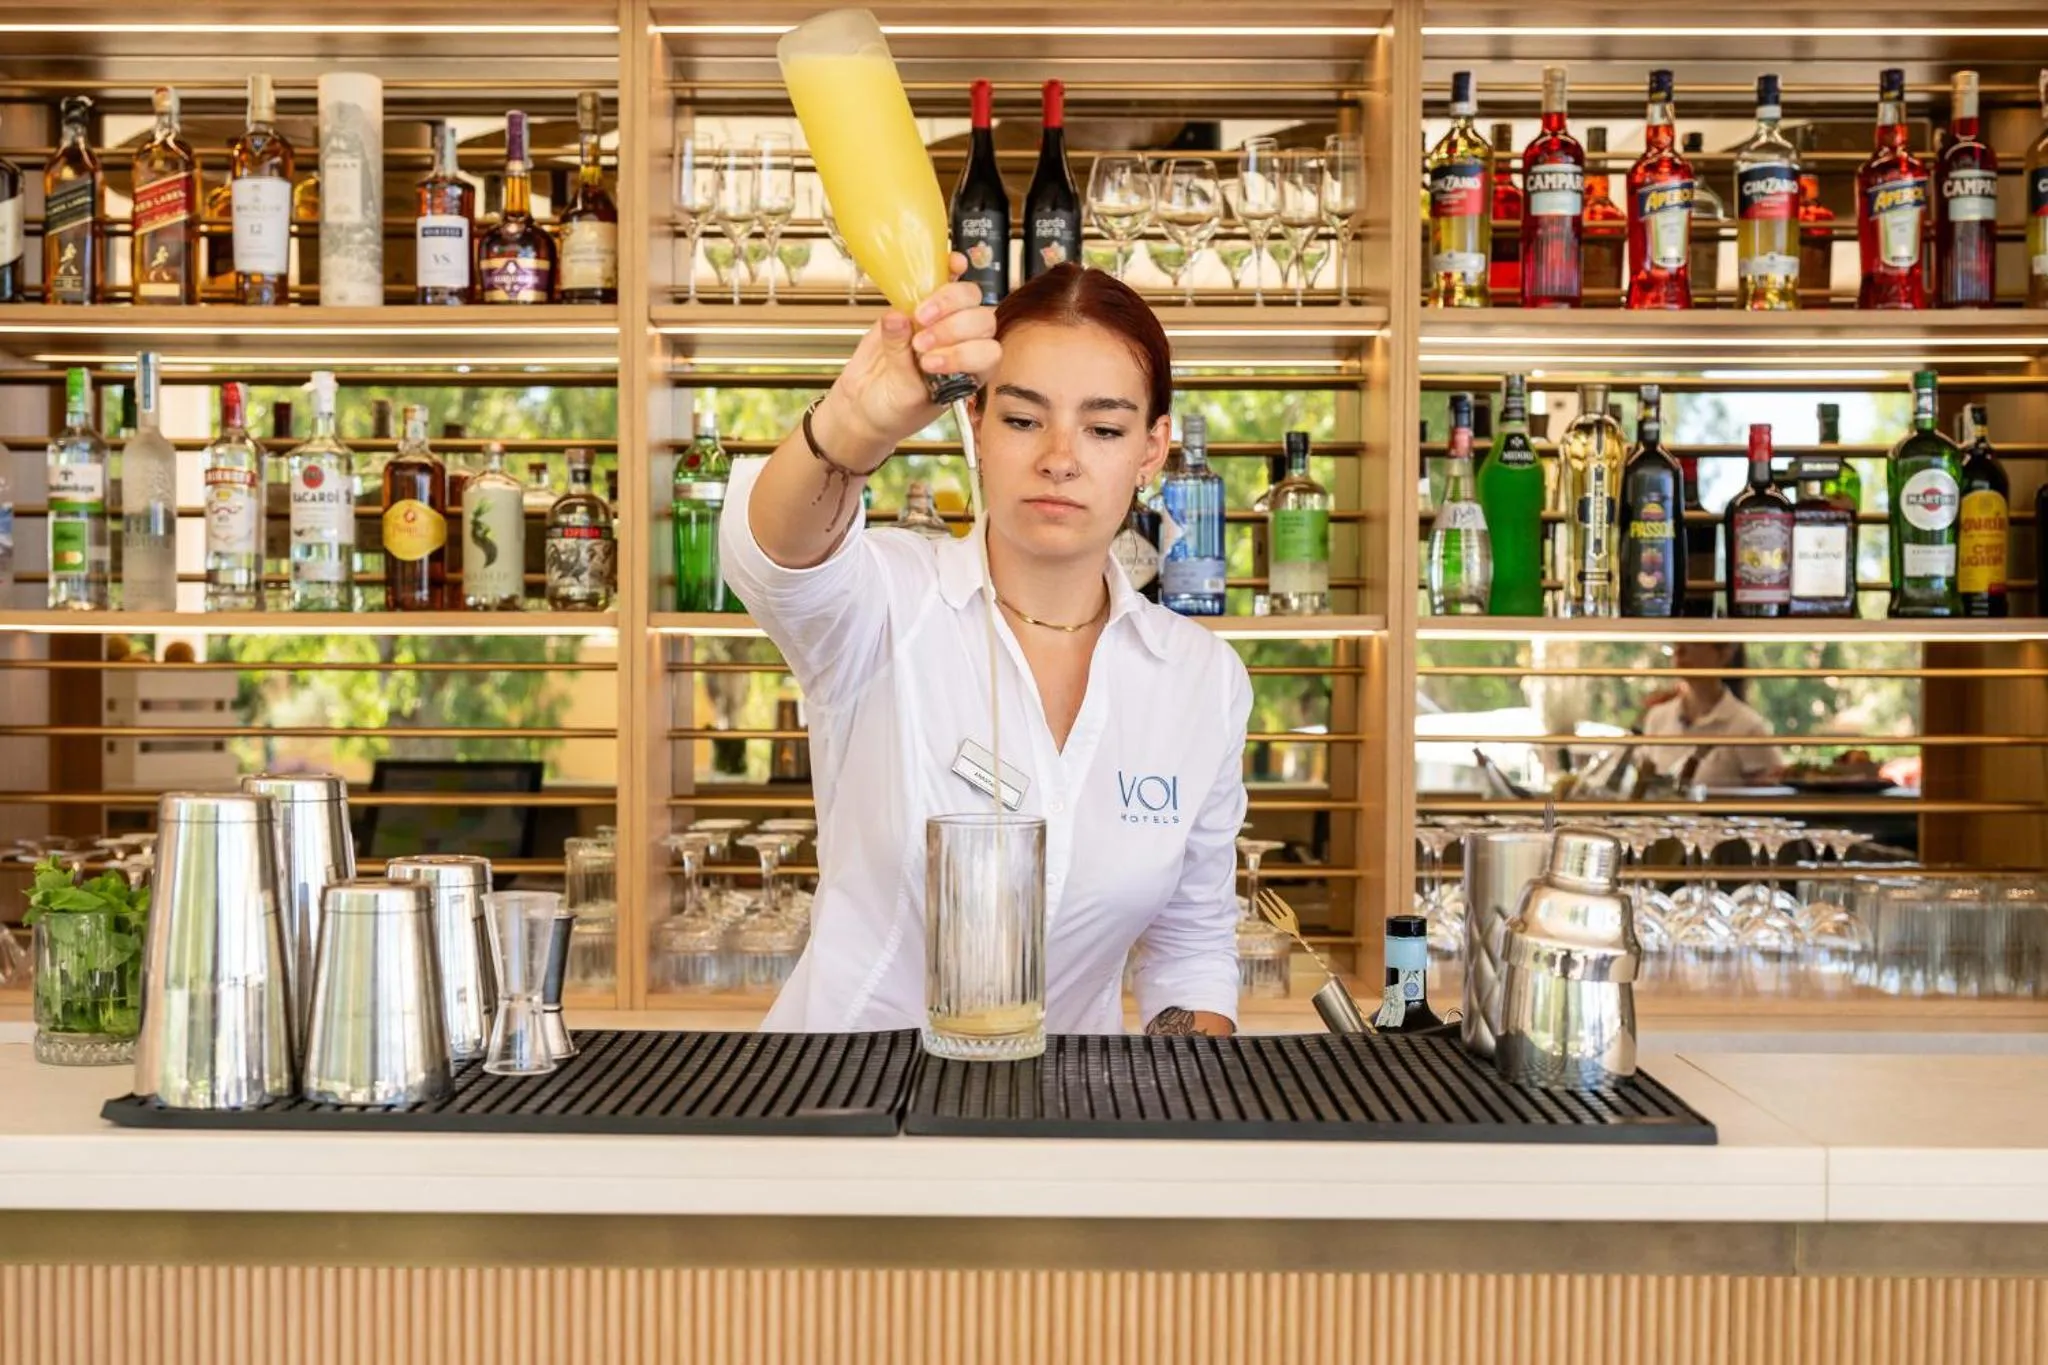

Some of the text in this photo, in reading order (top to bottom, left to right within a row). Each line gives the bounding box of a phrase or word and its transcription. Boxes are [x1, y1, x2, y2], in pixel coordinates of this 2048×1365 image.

[1743, 177, 1799, 194] CINZANO
[962, 217, 992, 228] carda
[1035, 217, 1066, 228] carda
[962, 227, 988, 237] nera
[1035, 227, 1061, 237] nera
[1906, 494, 1956, 506] MARTINI
[1118, 770, 1178, 811] VOI
[1120, 812, 1180, 824] HOTELS
